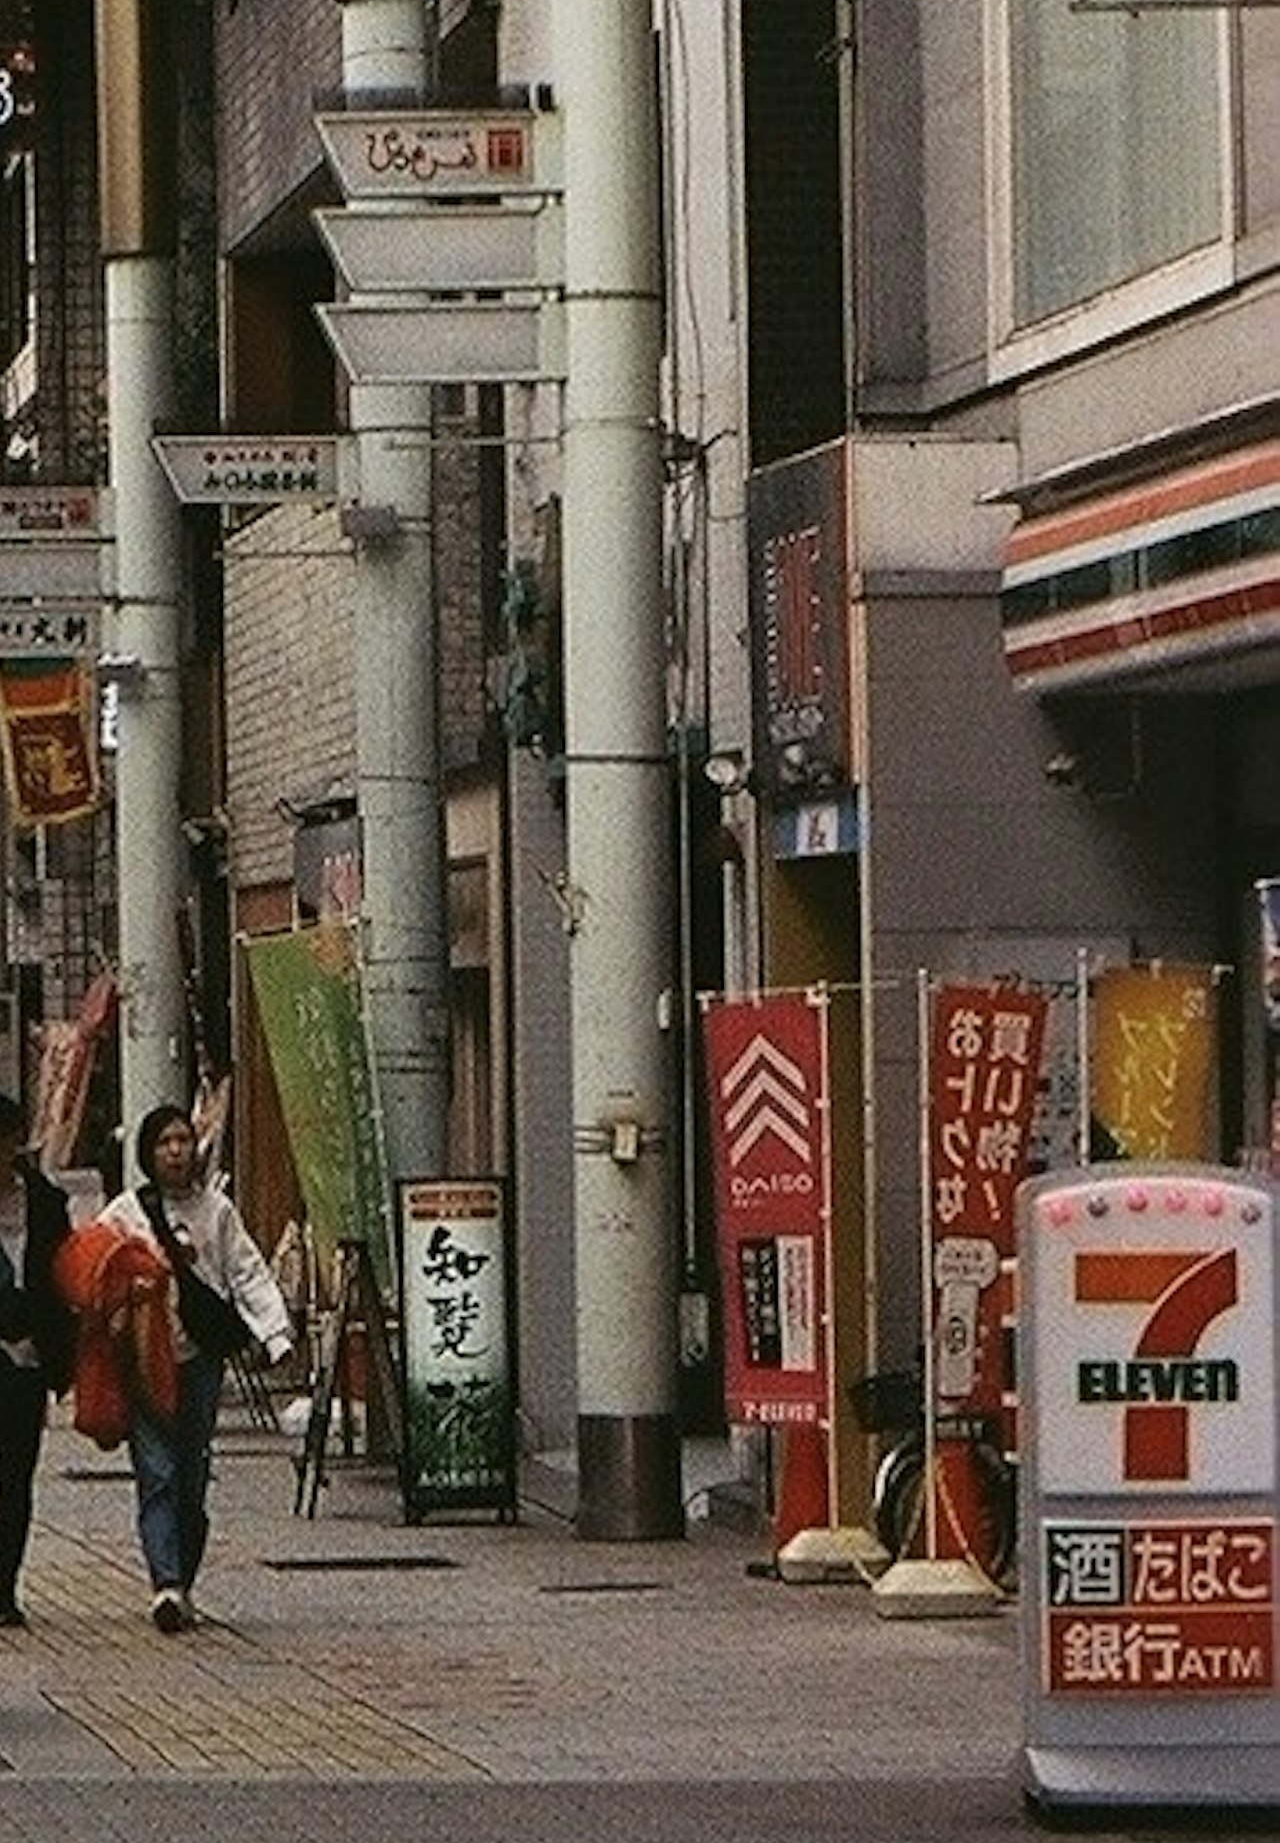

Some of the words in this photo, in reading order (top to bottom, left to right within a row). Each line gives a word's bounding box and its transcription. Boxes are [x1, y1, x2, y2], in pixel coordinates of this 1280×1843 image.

[730, 1174, 813, 1197] DAISO
[1052, 1531, 1122, 1604] 酒
[1133, 1530, 1269, 1602] たばこ
